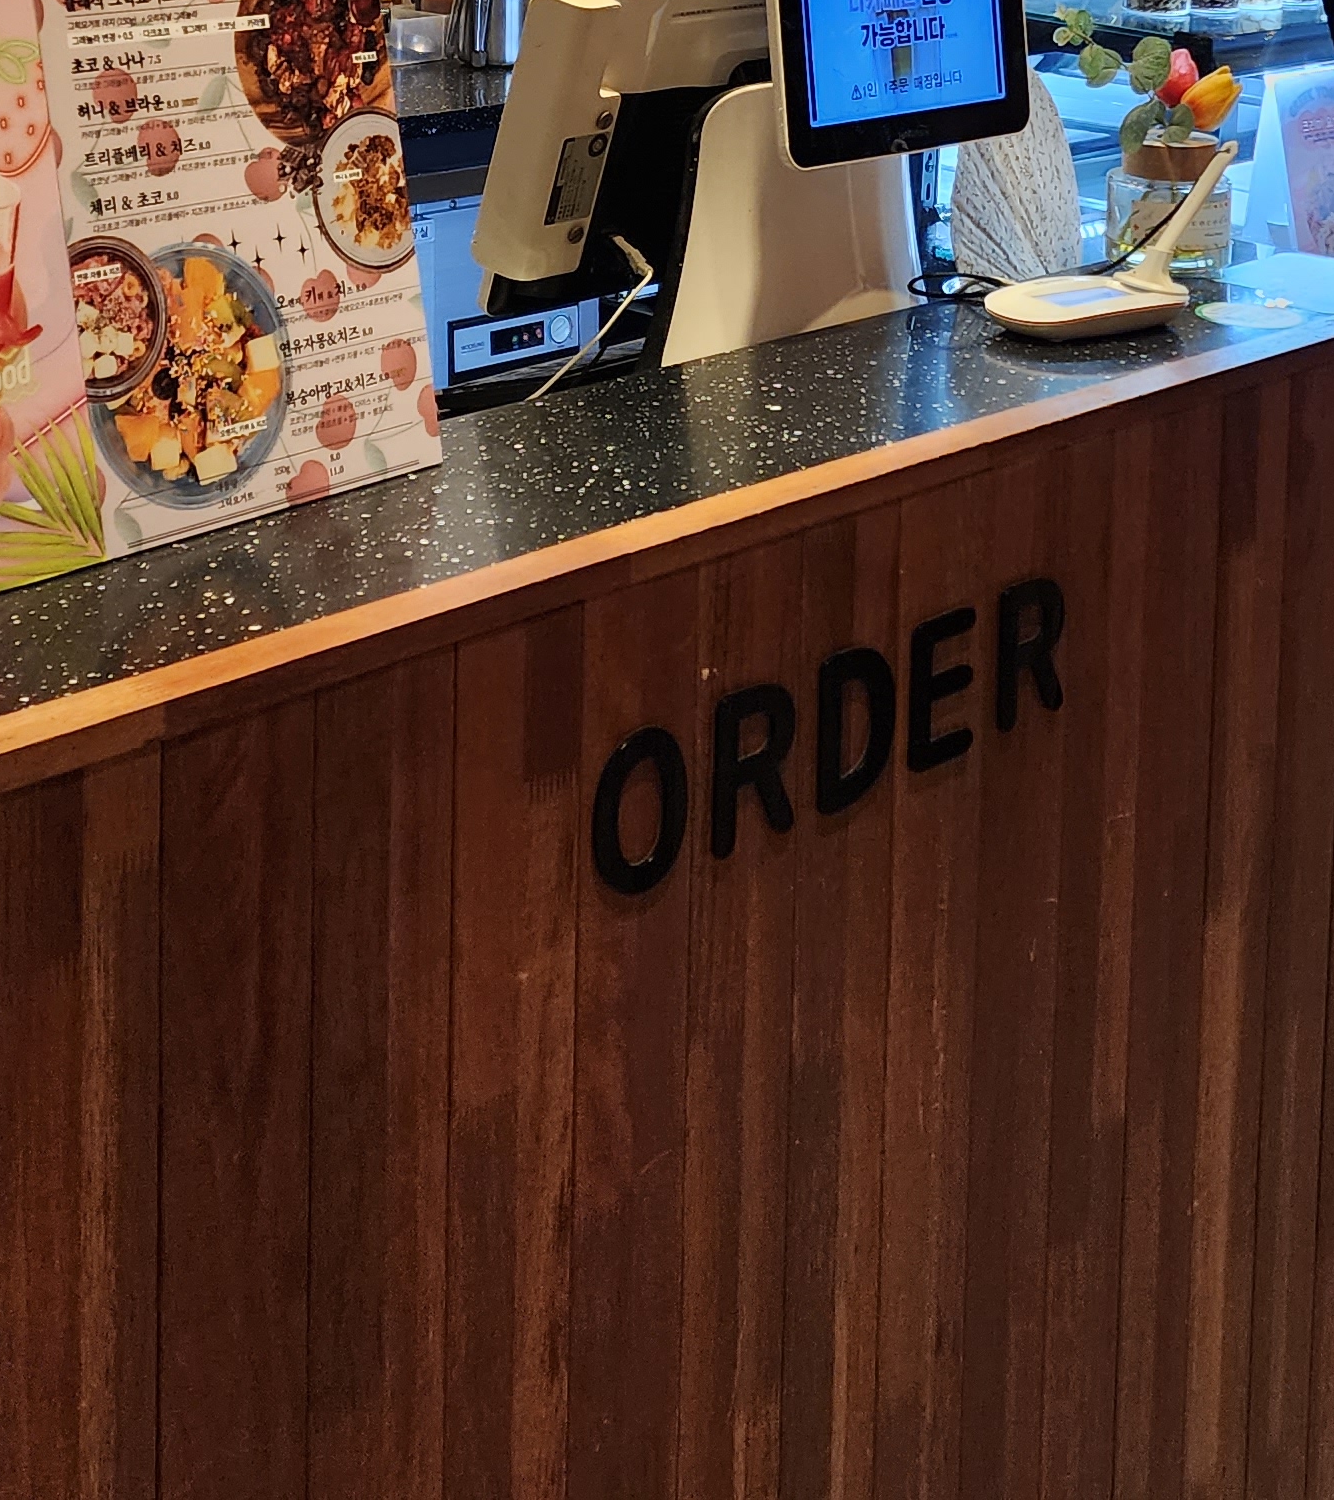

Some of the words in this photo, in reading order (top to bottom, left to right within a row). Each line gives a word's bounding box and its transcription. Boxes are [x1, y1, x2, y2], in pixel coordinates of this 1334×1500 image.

[860, 16, 946, 49] 가능합니다
[71, 57, 100, 75] 초코
[77, 102, 105, 121] 허니
[125, 95, 165, 113] 브라운
[84, 142, 152, 168] 트리플베리
[171, 138, 197, 155] 치즈
[90, 196, 117, 217] 체리
[137, 190, 164, 208] 초코
[592, 577, 1065, 896] ORDER
